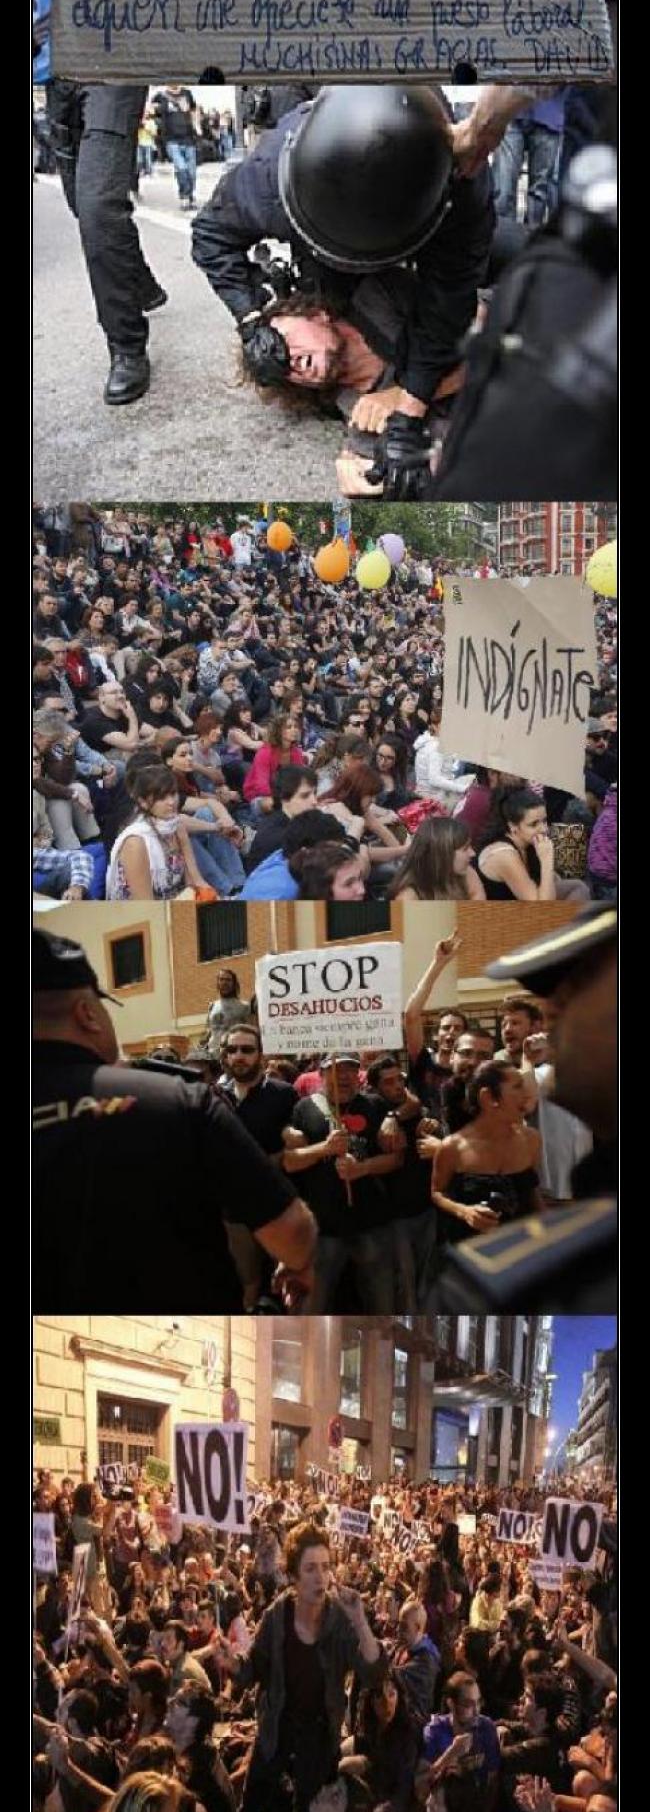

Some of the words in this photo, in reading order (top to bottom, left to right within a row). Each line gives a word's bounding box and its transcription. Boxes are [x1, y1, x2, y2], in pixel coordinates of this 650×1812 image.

[268, 956, 379, 998] STOP
[268, 995, 383, 1018] DESAHUCIOS
[175, 1429, 245, 1525] NO!
[498, 1512, 534, 1540] NO!
[543, 1503, 599, 1563] NO
